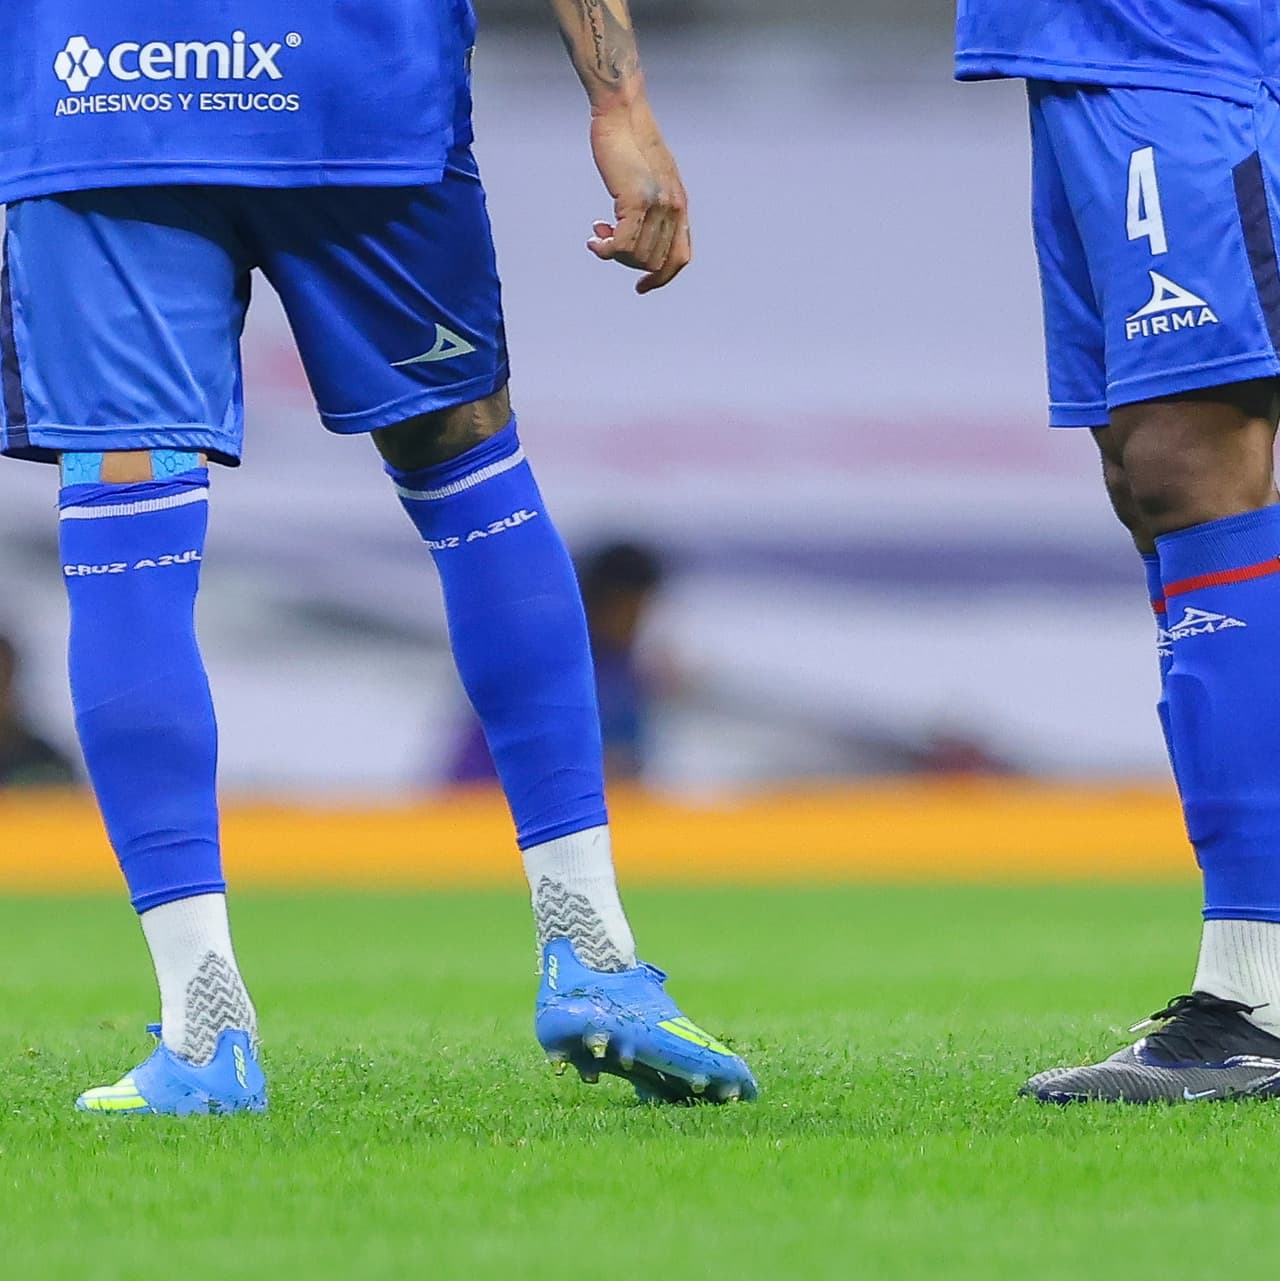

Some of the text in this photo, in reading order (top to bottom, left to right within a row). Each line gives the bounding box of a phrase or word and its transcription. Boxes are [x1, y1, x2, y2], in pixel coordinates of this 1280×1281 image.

[54, 93, 300, 117] ADHESIVOS Y ESTUCOS
[1126, 145, 1168, 255] 4
[1125, 307, 1219, 340] PIRMA
[466, 509, 538, 542] AZUL
[64, 550, 203, 576] CRUZ AZUL
